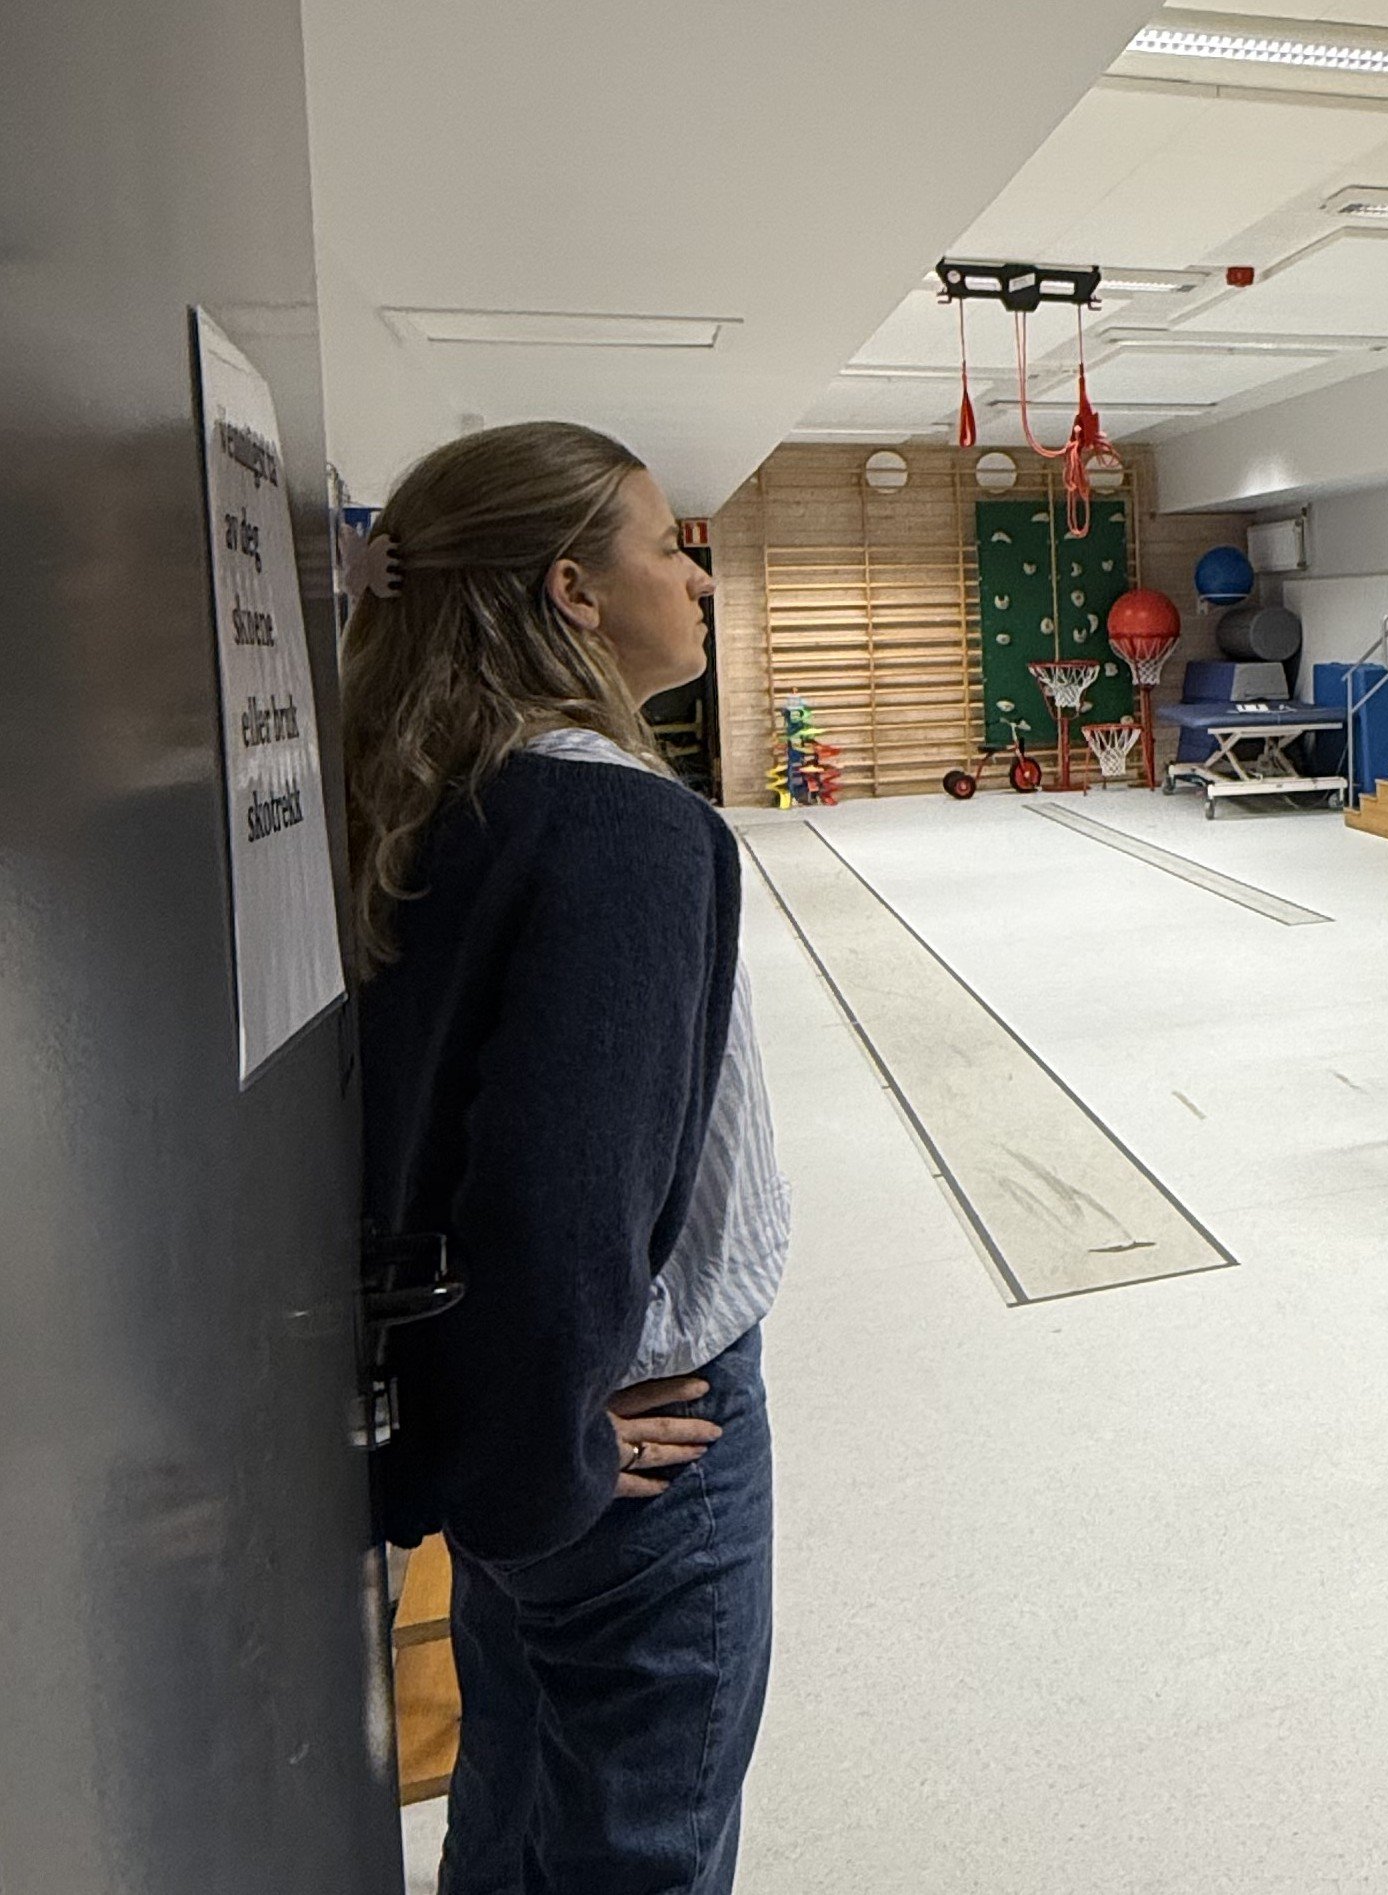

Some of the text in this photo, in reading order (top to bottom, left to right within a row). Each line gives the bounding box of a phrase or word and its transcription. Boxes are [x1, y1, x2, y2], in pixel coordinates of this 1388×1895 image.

[240, 506, 262, 573] deg
[241, 694, 300, 748] eller bruk
[248, 778, 304, 842] skotrekk
